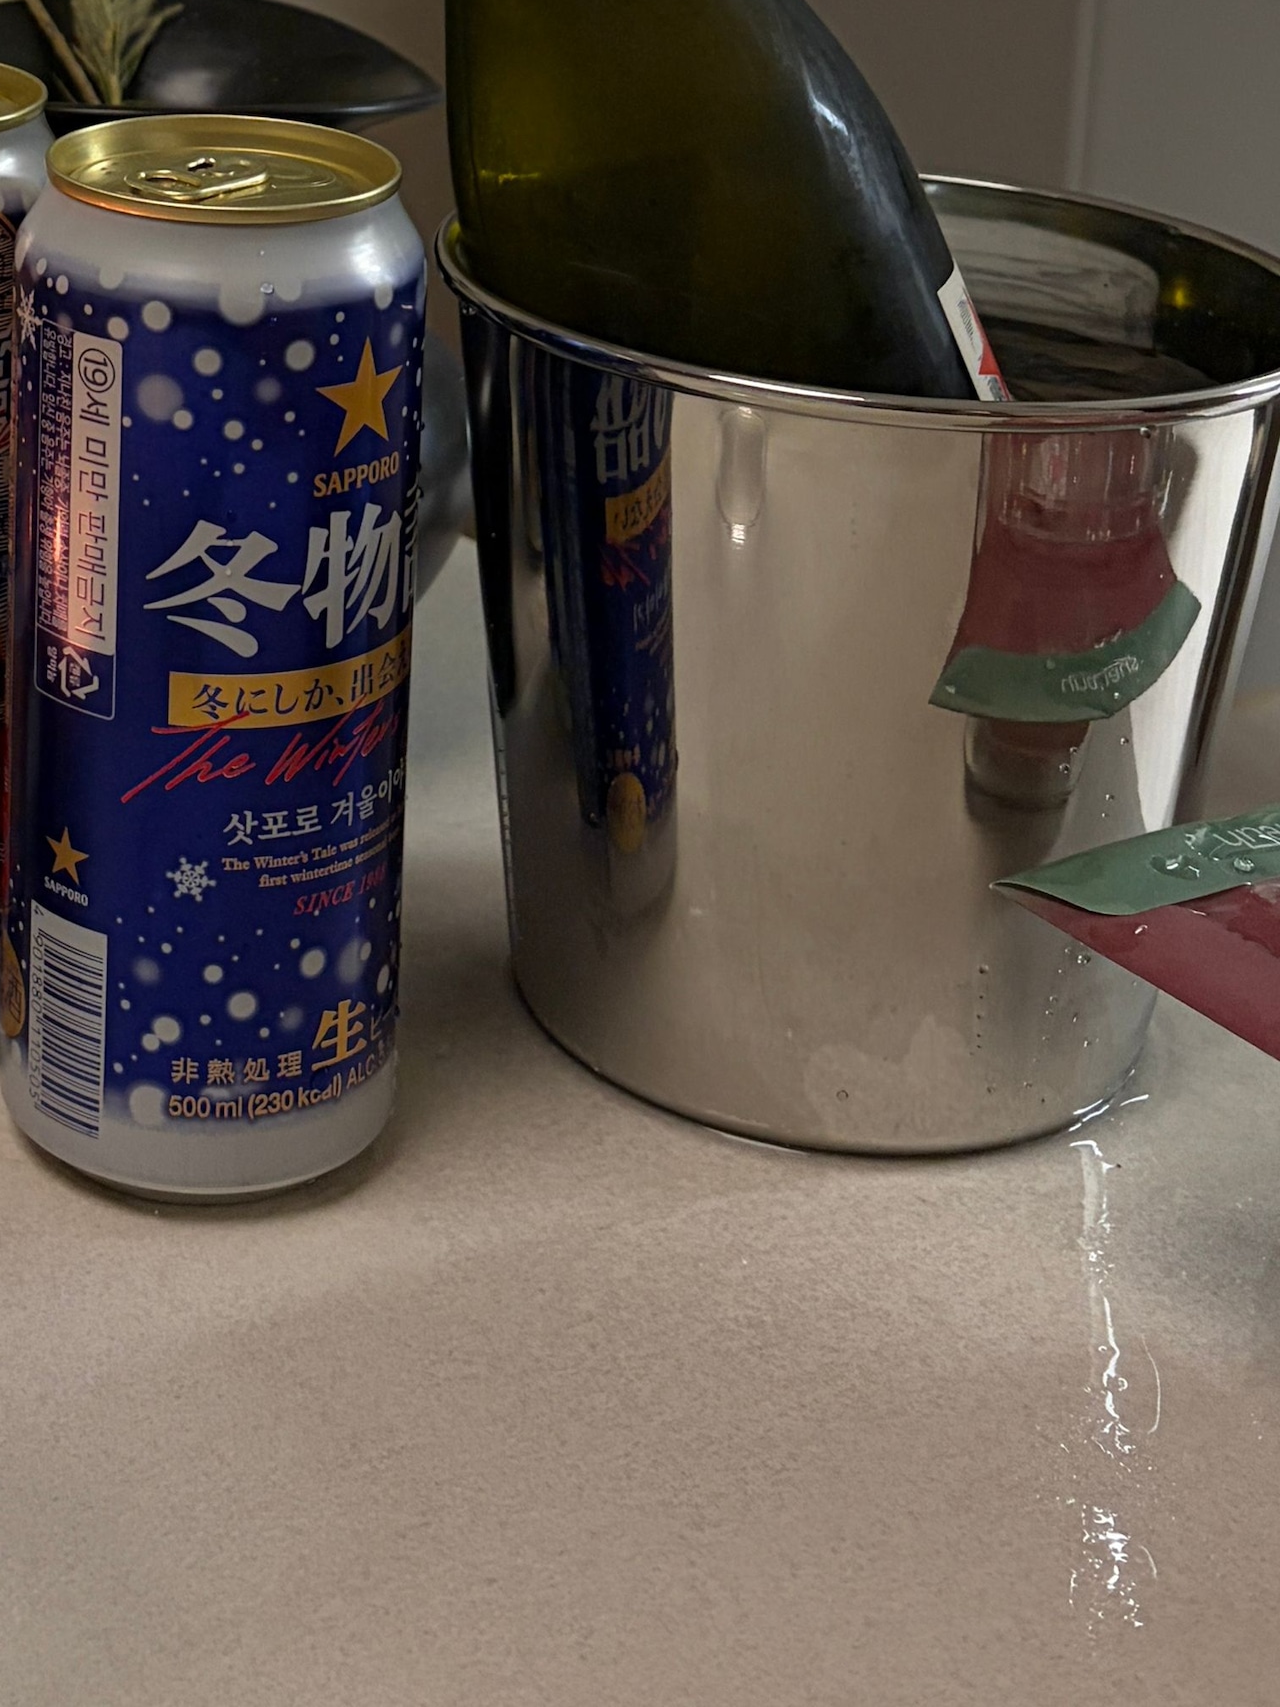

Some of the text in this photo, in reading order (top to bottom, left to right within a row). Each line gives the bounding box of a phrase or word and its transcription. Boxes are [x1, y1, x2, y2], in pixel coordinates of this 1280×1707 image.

[56, 335, 72, 359] 경고
[41, 391, 57, 418] 임신
[56, 369, 72, 410] 지나친
[55, 411, 70, 451] 음주는
[40, 433, 56, 472] 음주는
[77, 438, 111, 503] 미만
[313, 450, 400, 499] SAPPORO
[74, 511, 108, 642] 판매금지
[121, 710, 257, 803] The
[222, 804, 323, 847] 삿포로
[222, 857, 251, 872] The
[253, 850, 309, 871] Winter's
[311, 844, 338, 862] Tale
[339, 837, 359, 853] was
[258, 872, 288, 889] first
[290, 856, 354, 883] wintertime
[43, 875, 89, 908] SAPPORO
[293, 880, 357, 918] SINCE
[28, 904, 45, 1099] 4 901880 110505
[168, 1095, 211, 1119] 500
[215, 1095, 243, 1119] ml
[247, 1088, 295, 1120] (230
[298, 1072, 343, 1109] kcal)
